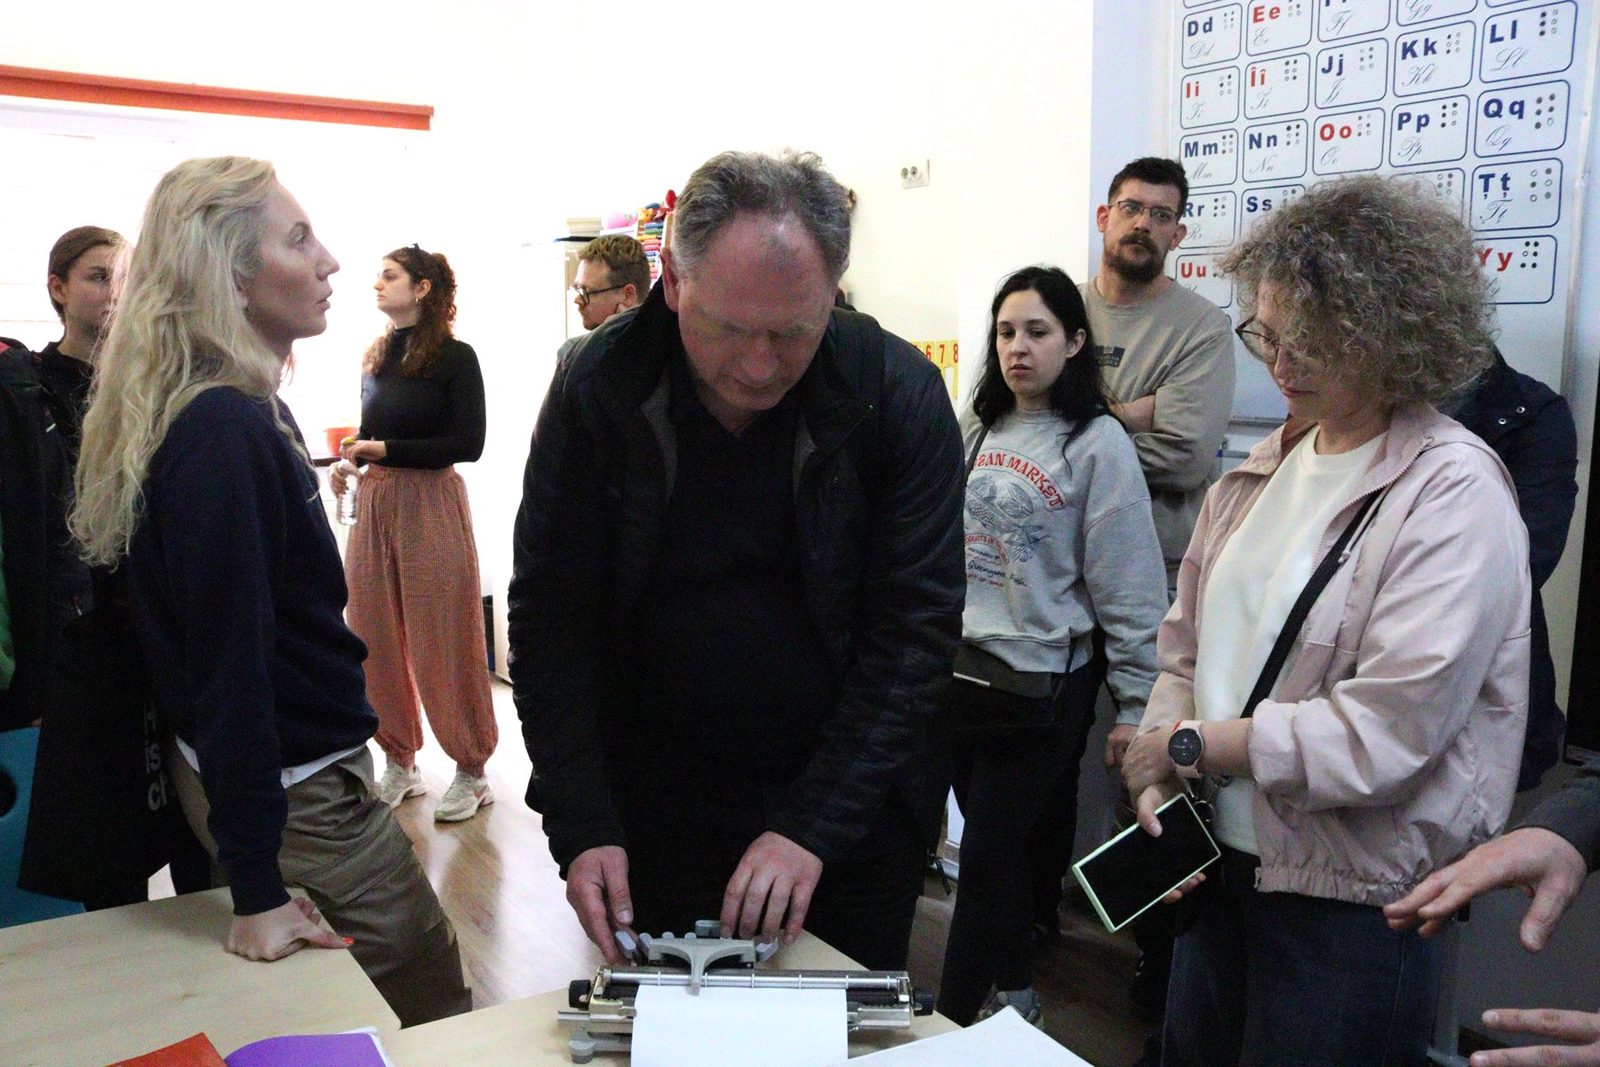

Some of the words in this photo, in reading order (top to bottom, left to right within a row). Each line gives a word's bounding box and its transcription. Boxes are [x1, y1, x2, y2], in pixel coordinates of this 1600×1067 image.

[1253, 5, 1281, 23] Ee
[1187, 17, 1213, 37] Dd
[1401, 37, 1437, 60] Kk
[1321, 54, 1344, 76] Jj
[1483, 98, 1525, 119] Qq
[1319, 123, 1352, 142] Oo
[1397, 112, 1430, 133] Pp
[1184, 141, 1218, 158] Mm
[1249, 133, 1278, 150] Nn
[1246, 196, 1272, 213] Ss
[1181, 262, 1206, 278] Uu
[939, 344, 945, 364] 7
[953, 343, 959, 363] 8
[974, 452, 1006, 469] EAN
[1007, 456, 1064, 507] MARKET
